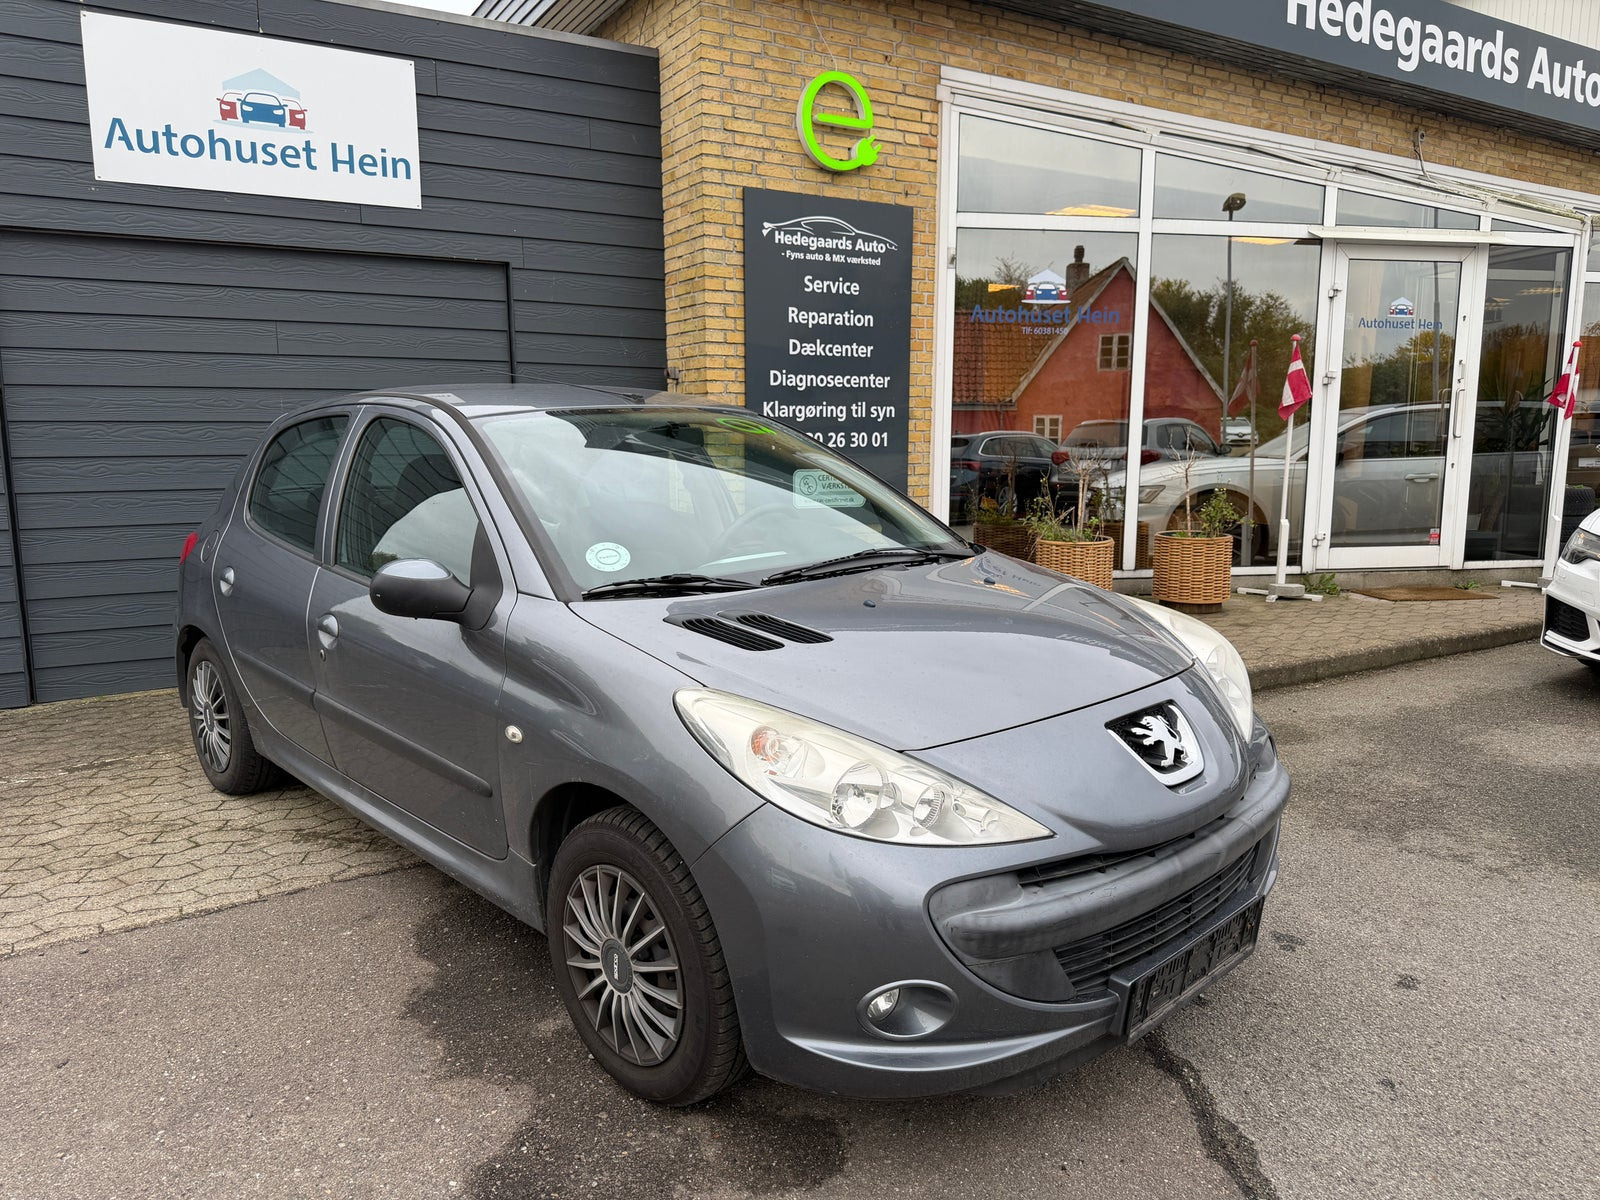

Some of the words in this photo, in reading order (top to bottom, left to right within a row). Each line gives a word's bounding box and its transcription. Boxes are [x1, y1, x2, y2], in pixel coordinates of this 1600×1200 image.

[1287, 0, 1519, 84] Hedegaards
[1527, 46, 1600, 107] Auto
[104, 117, 317, 171] Autohuset
[331, 142, 412, 180] Hein
[774, 230, 853, 250] Hedegaards
[855, 238, 886, 253] Auto
[786, 250, 804, 261] Fyns
[805, 253, 824, 262] auto
[825, 254, 831, 262] &
[832, 254, 846, 263] MX
[846, 256, 881, 266] værksted
[804, 275, 860, 295] Service
[788, 306, 874, 328] Reparation
[970, 304, 1071, 324] Autohuset
[1077, 306, 1120, 324] Hein
[1358, 317, 1415, 330] Autohuset
[1418, 318, 1442, 330] Hein
[789, 338, 873, 358] Dækcenter
[769, 369, 891, 391] Diagnosecenter
[763, 401, 846, 422] Klargøring
[851, 401, 866, 418] til
[870, 405, 895, 422] syn
[805, 432, 823, 443] 0
[827, 432, 845, 448] 26
[850, 432, 868, 448] 30
[871, 432, 888, 447] 01
